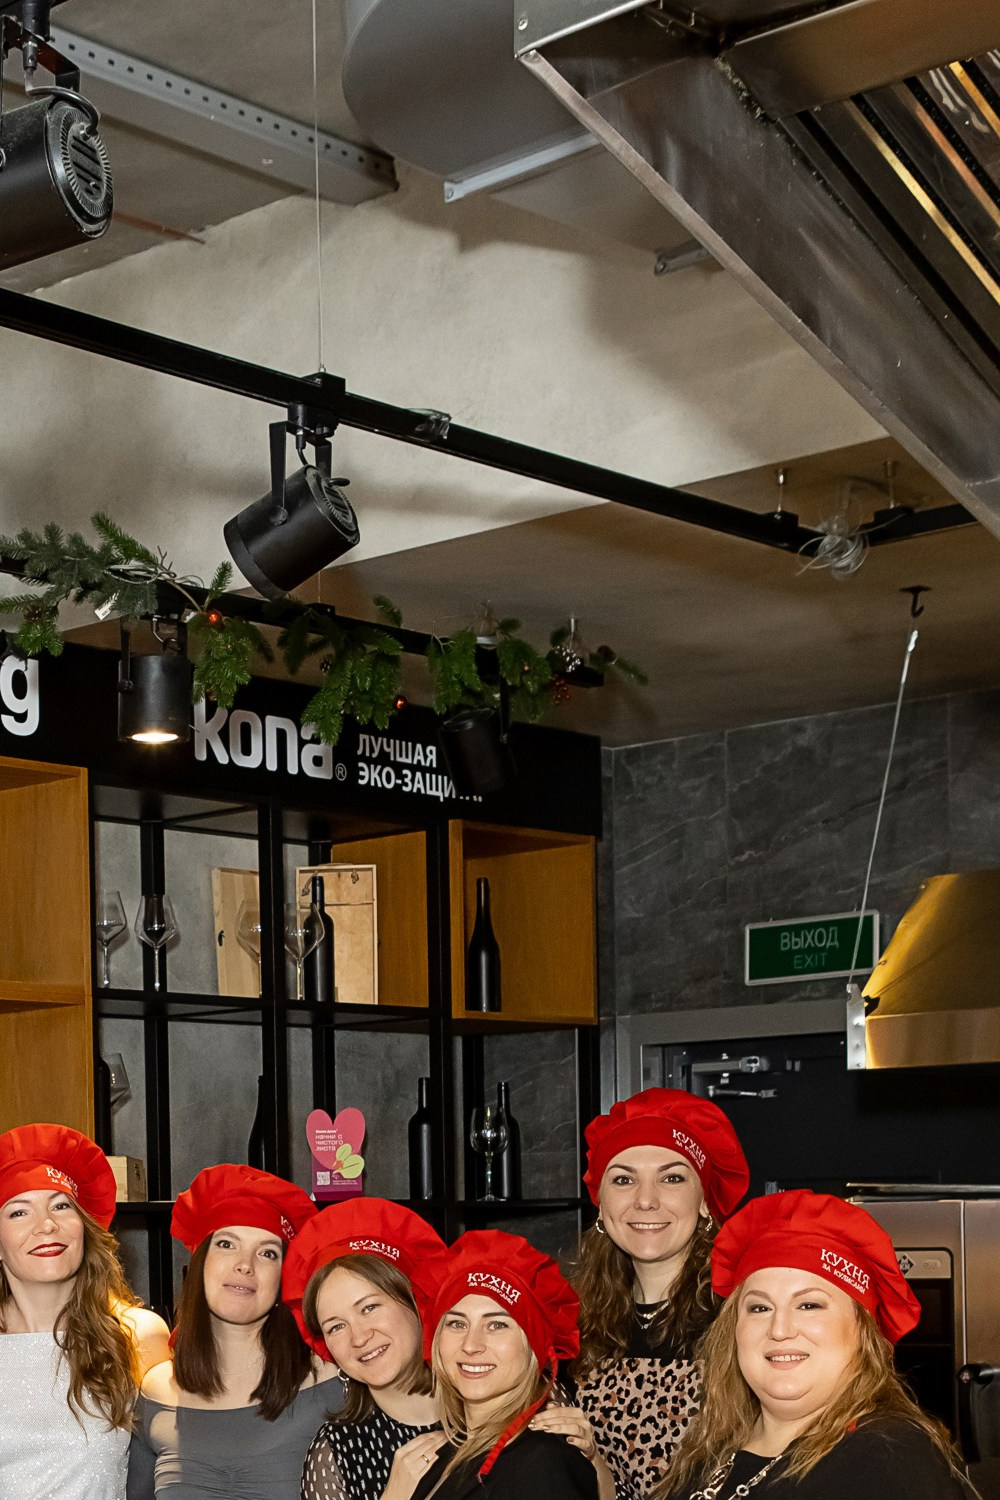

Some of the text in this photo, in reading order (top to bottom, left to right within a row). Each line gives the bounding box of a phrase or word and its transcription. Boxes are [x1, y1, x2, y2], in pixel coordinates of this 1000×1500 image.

[357, 733, 437, 768] ЛУЧШАЯ
[780, 927, 839, 951] ВЫХОД
[793, 952, 828, 969] EXIT
[672, 1129, 706, 1168] КУХНЯ
[349, 1239, 400, 1258] КУХНЯ
[820, 1248, 870, 1290] КУХНЯ
[466, 1272, 521, 1303] КУХНЯ
